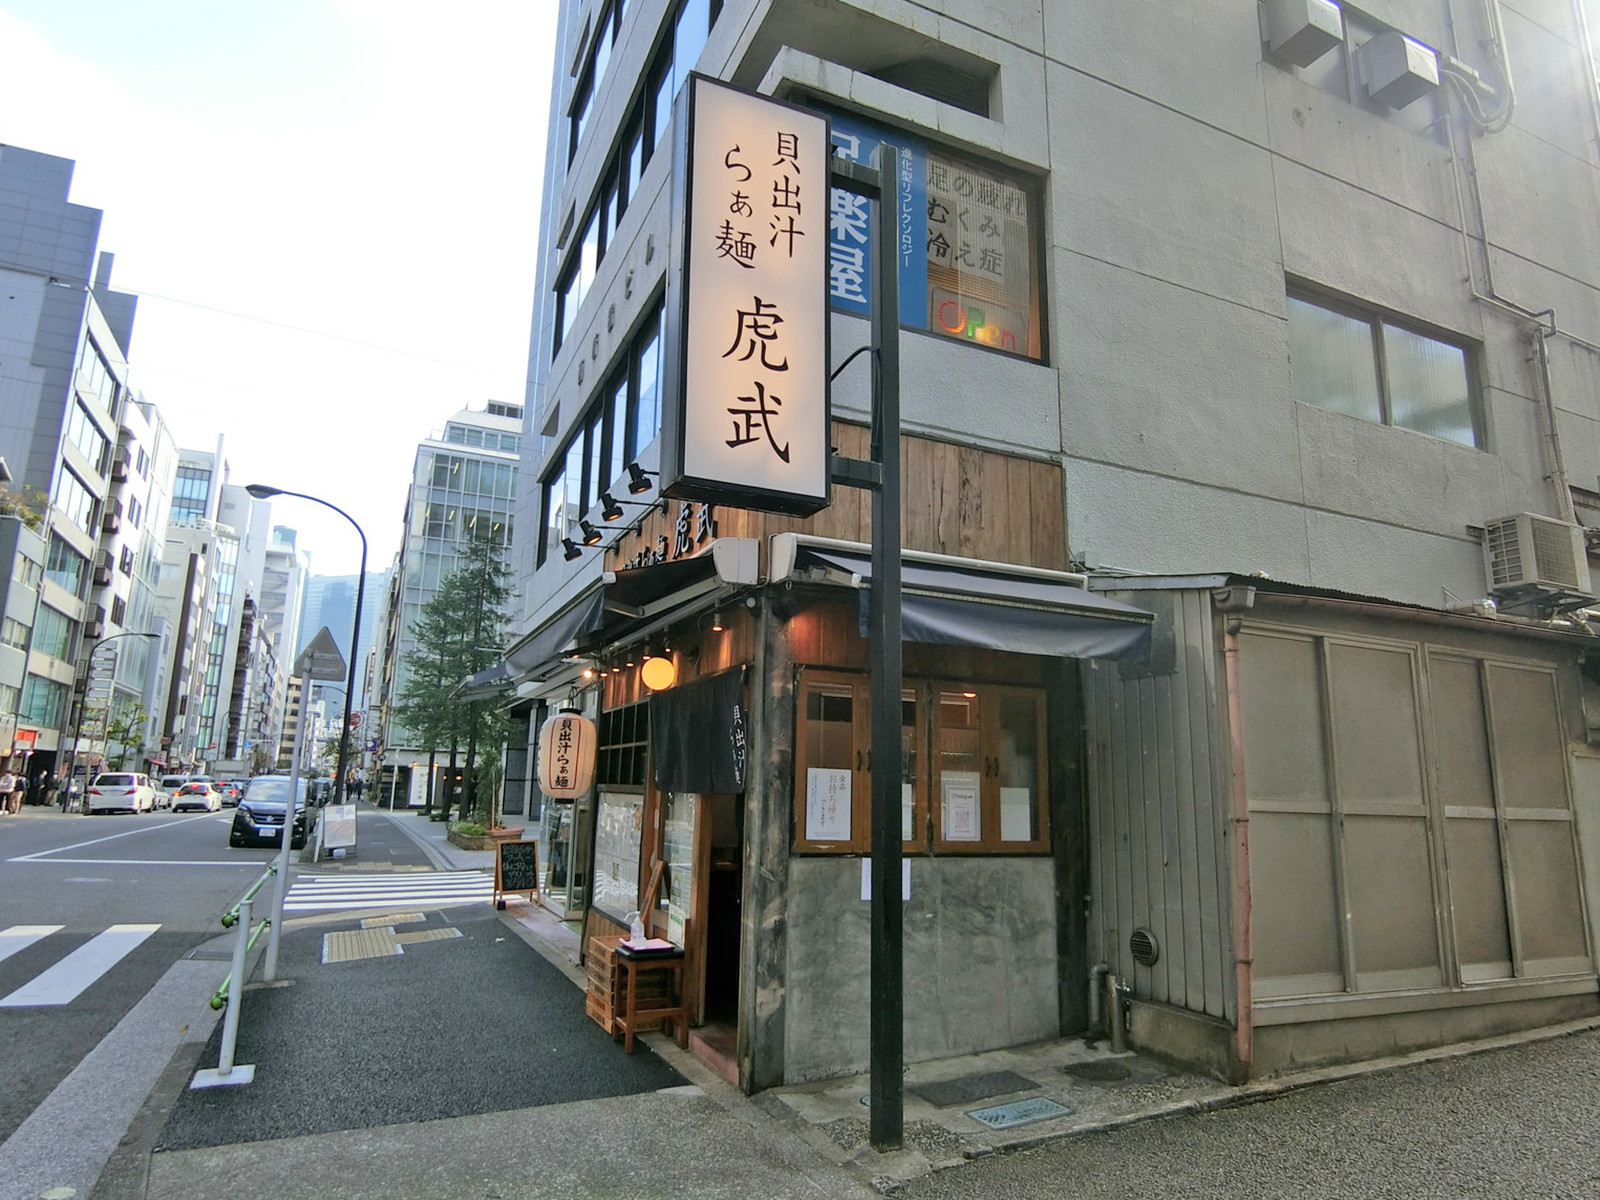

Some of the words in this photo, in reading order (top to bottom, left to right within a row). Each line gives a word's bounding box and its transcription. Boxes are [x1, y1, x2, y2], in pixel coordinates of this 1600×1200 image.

[714, 144, 758, 269] らぁ麺
[769, 131, 805, 258] 貝出汁
[901, 147, 913, 268] 進化型リフレクソロジー
[927, 197, 1000, 238] むくみ
[927, 228, 1003, 276] 冷え症
[721, 296, 790, 464] 虎武
[673, 502, 717, 559] 虎武
[555, 719, 573, 787] 貝出汁らぁ麺
